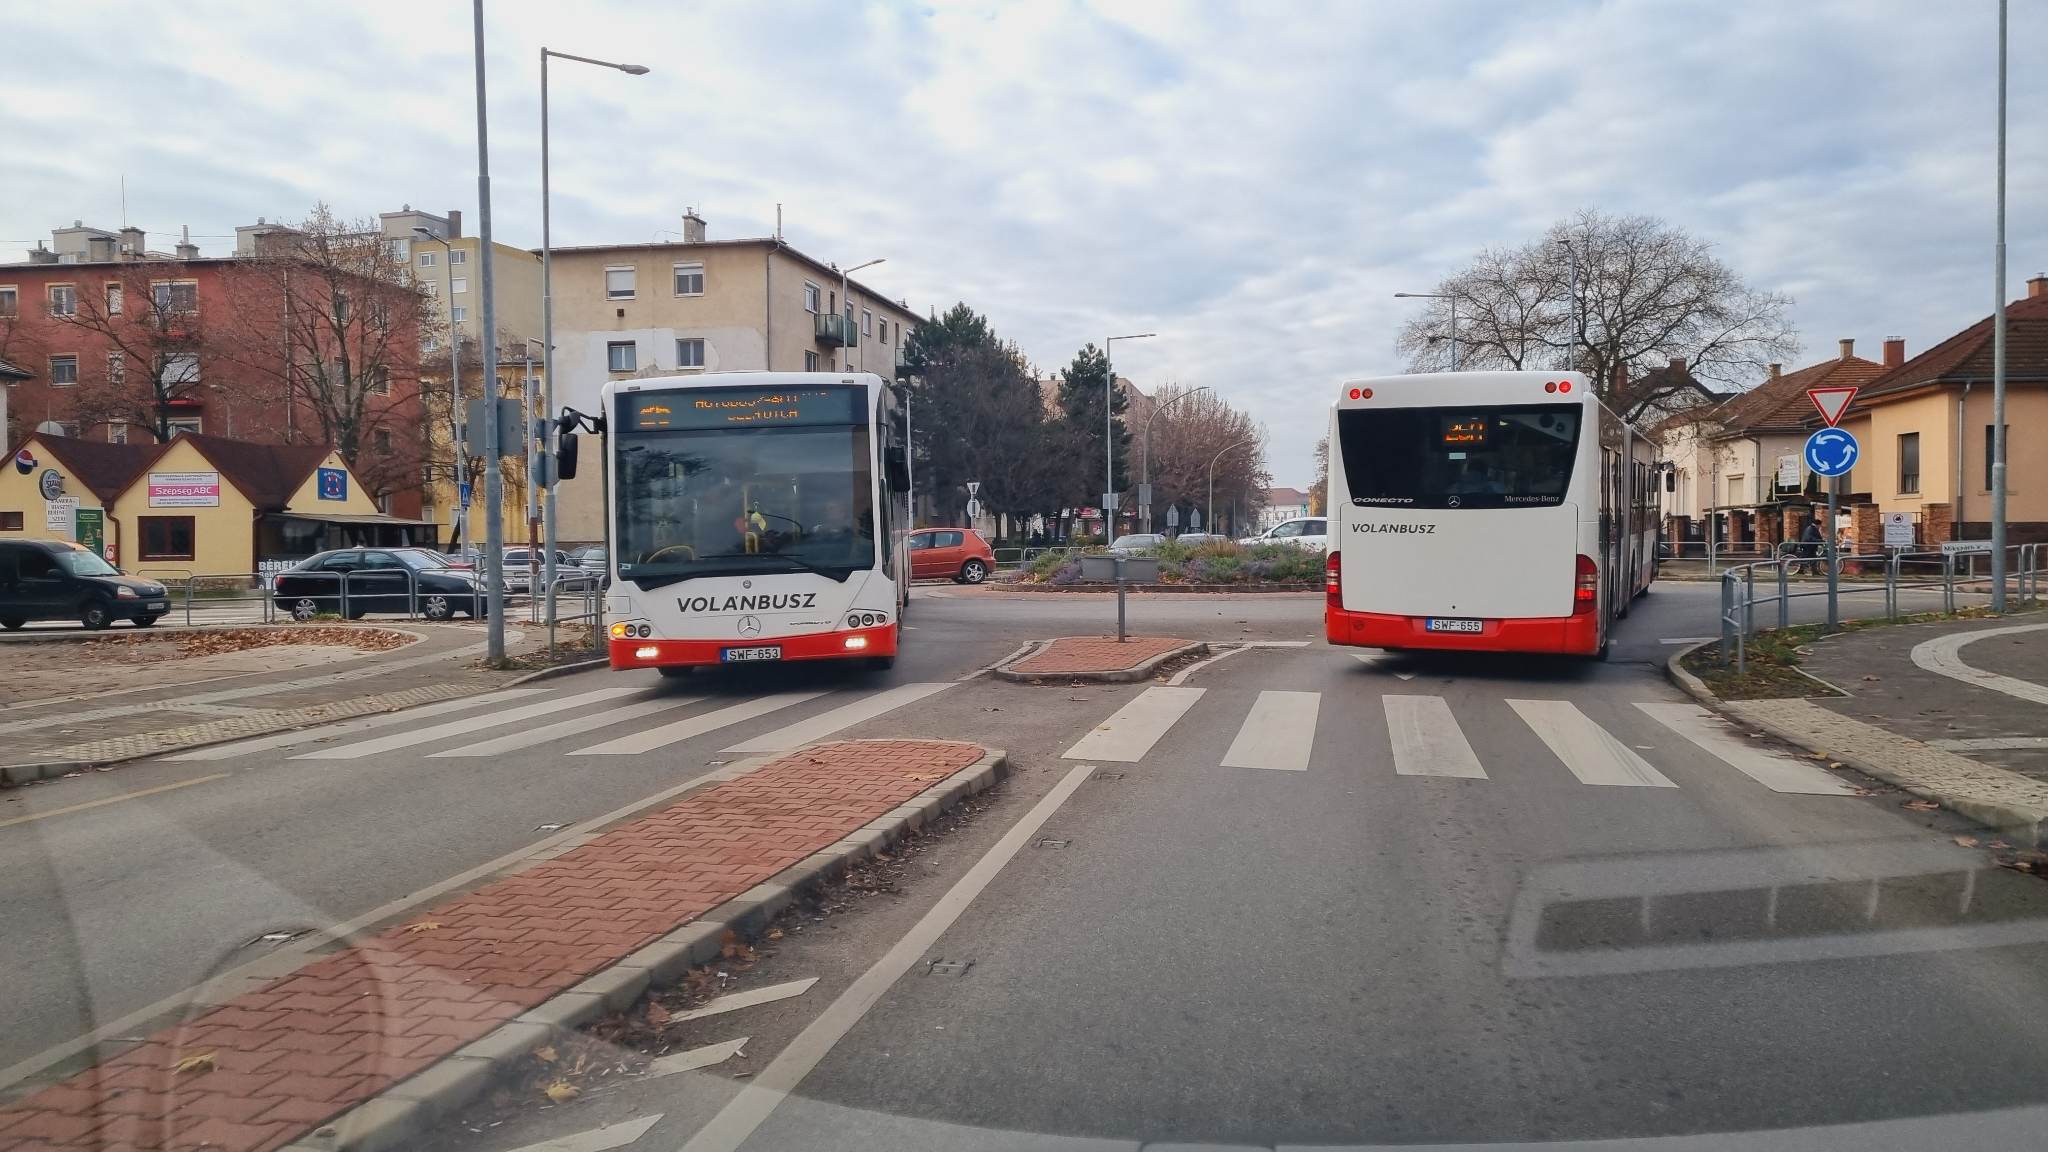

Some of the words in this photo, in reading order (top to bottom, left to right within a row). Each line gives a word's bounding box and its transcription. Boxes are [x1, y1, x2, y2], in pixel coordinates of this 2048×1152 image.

[1504, 494, 1560, 503] Mercedes-Benz
[1352, 523, 1437, 534] VOLÁNBUSZ
[677, 593, 817, 613] VOLÁNBUSZ
[1433, 620, 1480, 631] SWF-655
[729, 648, 779, 661] SWF-653
